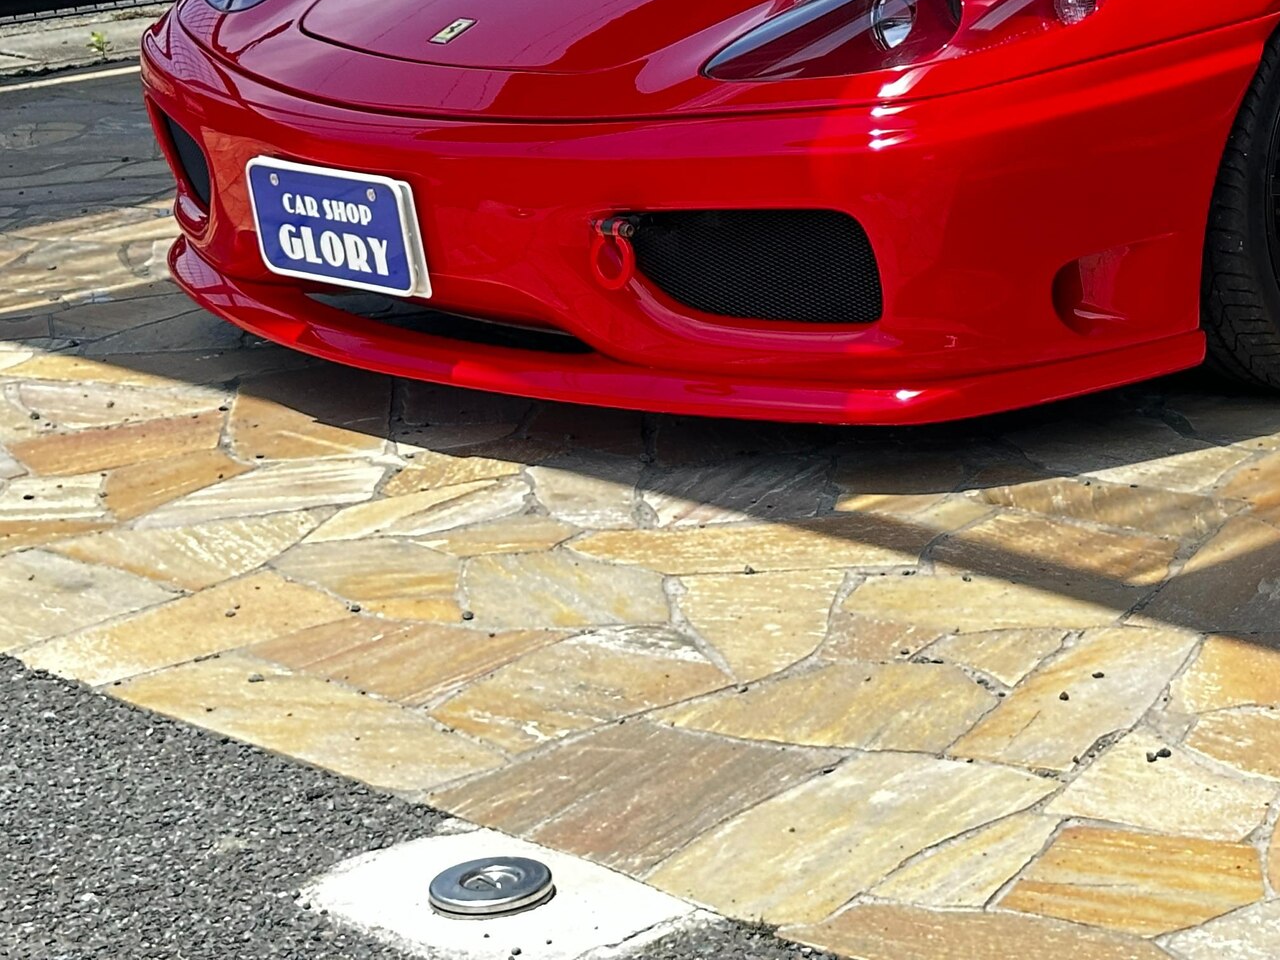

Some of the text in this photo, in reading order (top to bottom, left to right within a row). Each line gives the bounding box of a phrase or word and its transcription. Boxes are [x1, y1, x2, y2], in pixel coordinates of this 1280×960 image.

[282, 192, 372, 226] CAR SHOP
[278, 223, 389, 275] GLORY
